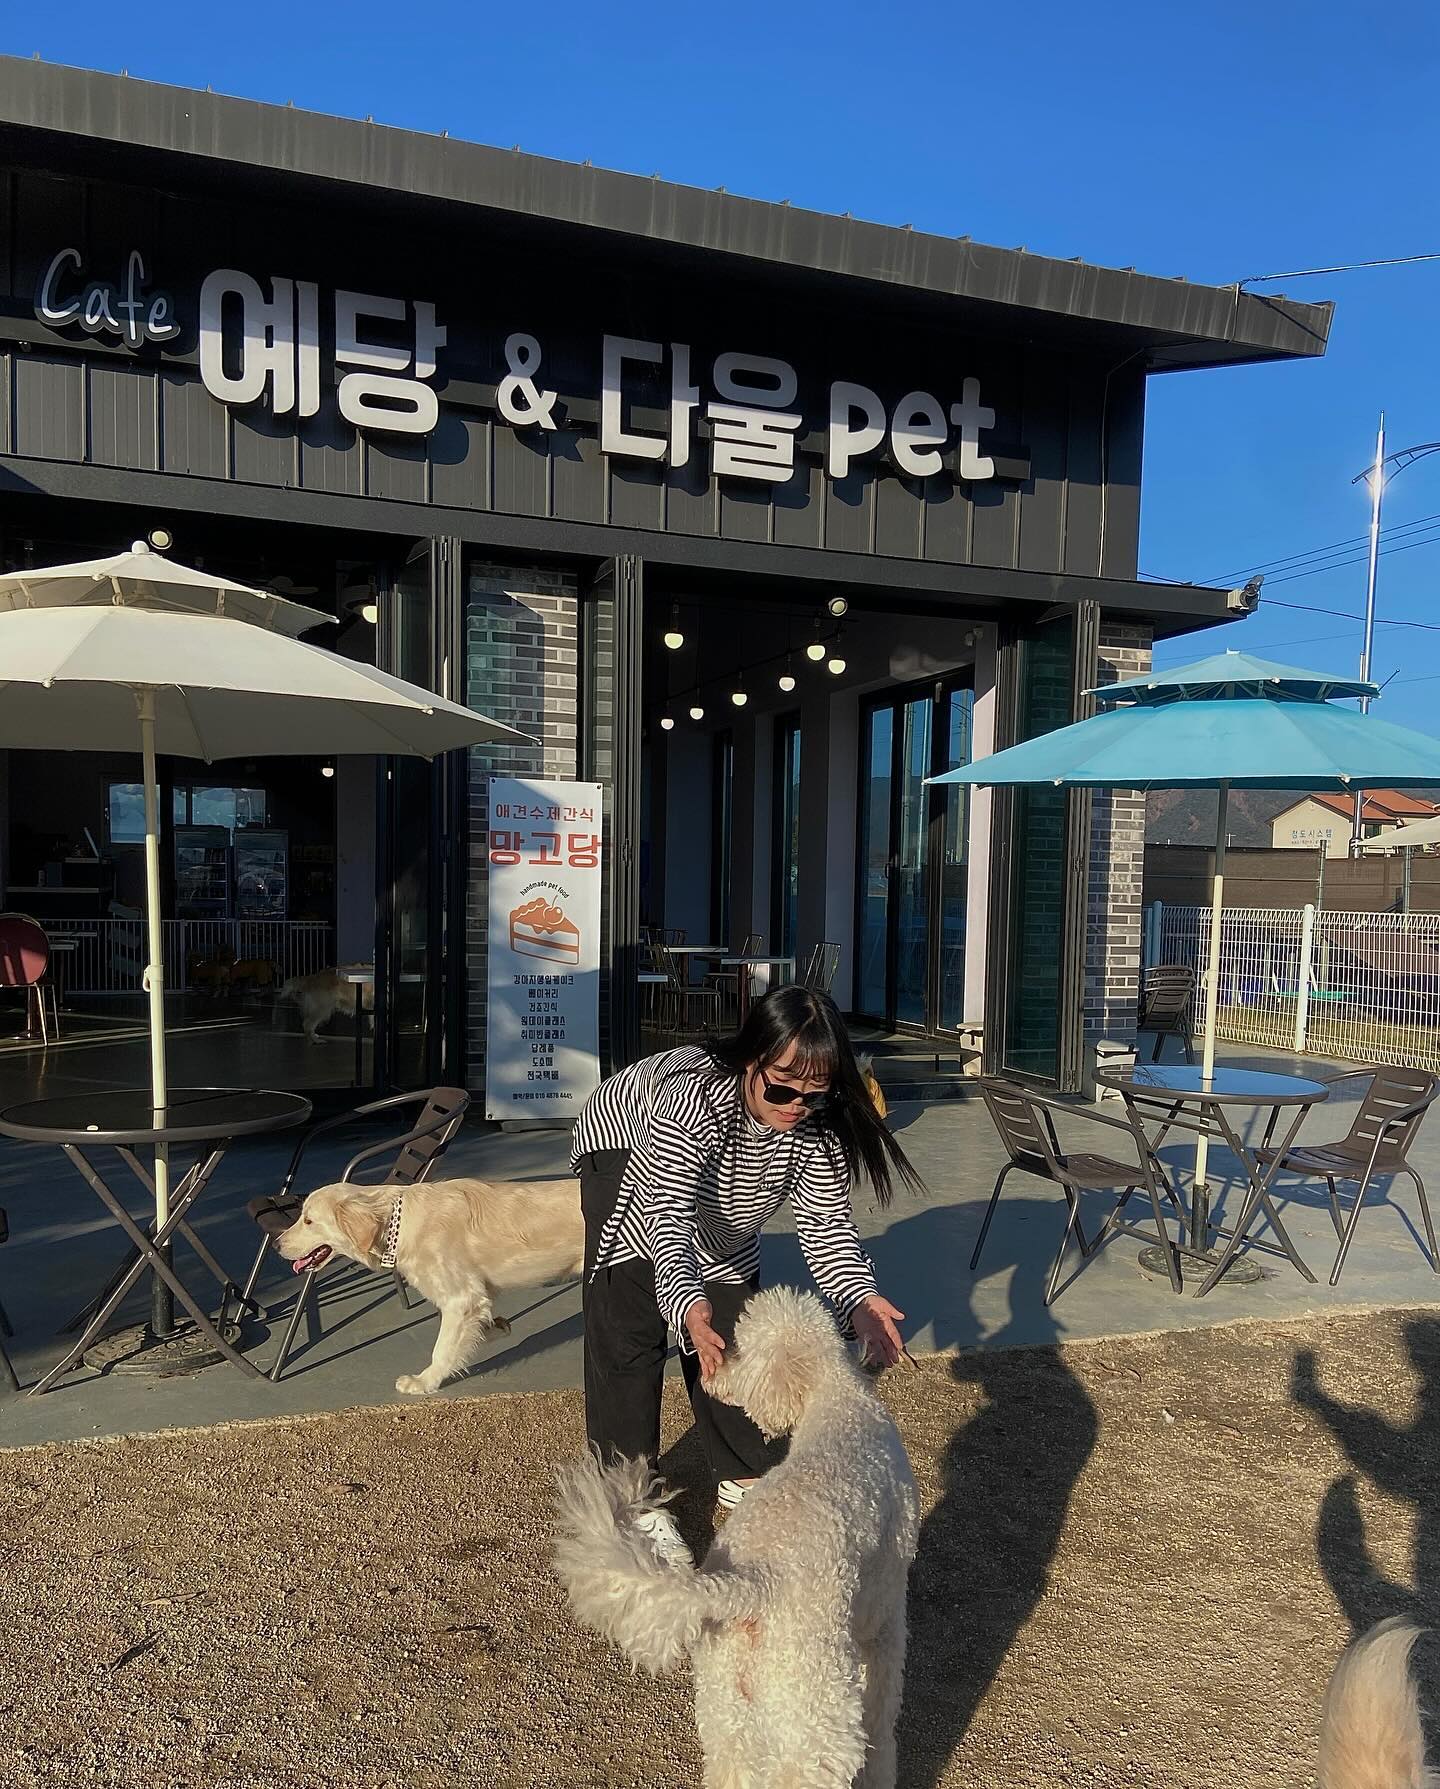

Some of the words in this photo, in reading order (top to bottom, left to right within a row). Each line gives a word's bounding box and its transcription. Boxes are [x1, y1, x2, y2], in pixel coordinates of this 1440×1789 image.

[36, 248, 180, 347] Cafe
[200, 269, 447, 433] 예당
[497, 333, 558, 430] &
[601, 334, 802, 482] 다울
[828, 377, 995, 479] pet
[496, 804, 594, 822] 애견수제간식
[490, 830, 602, 868] 망고당
[520, 880, 547, 896] handmade
[547, 882, 558, 891] pet
[557, 886, 570, 899] food
[528, 988, 559, 999] 베이커리
[529, 1002, 558, 1012] 건조간식
[521, 1015, 566, 1026] 원데이클래스
[521, 1029, 566, 1040] 취미반클래스
[532, 1056, 553, 1067] 도소매
